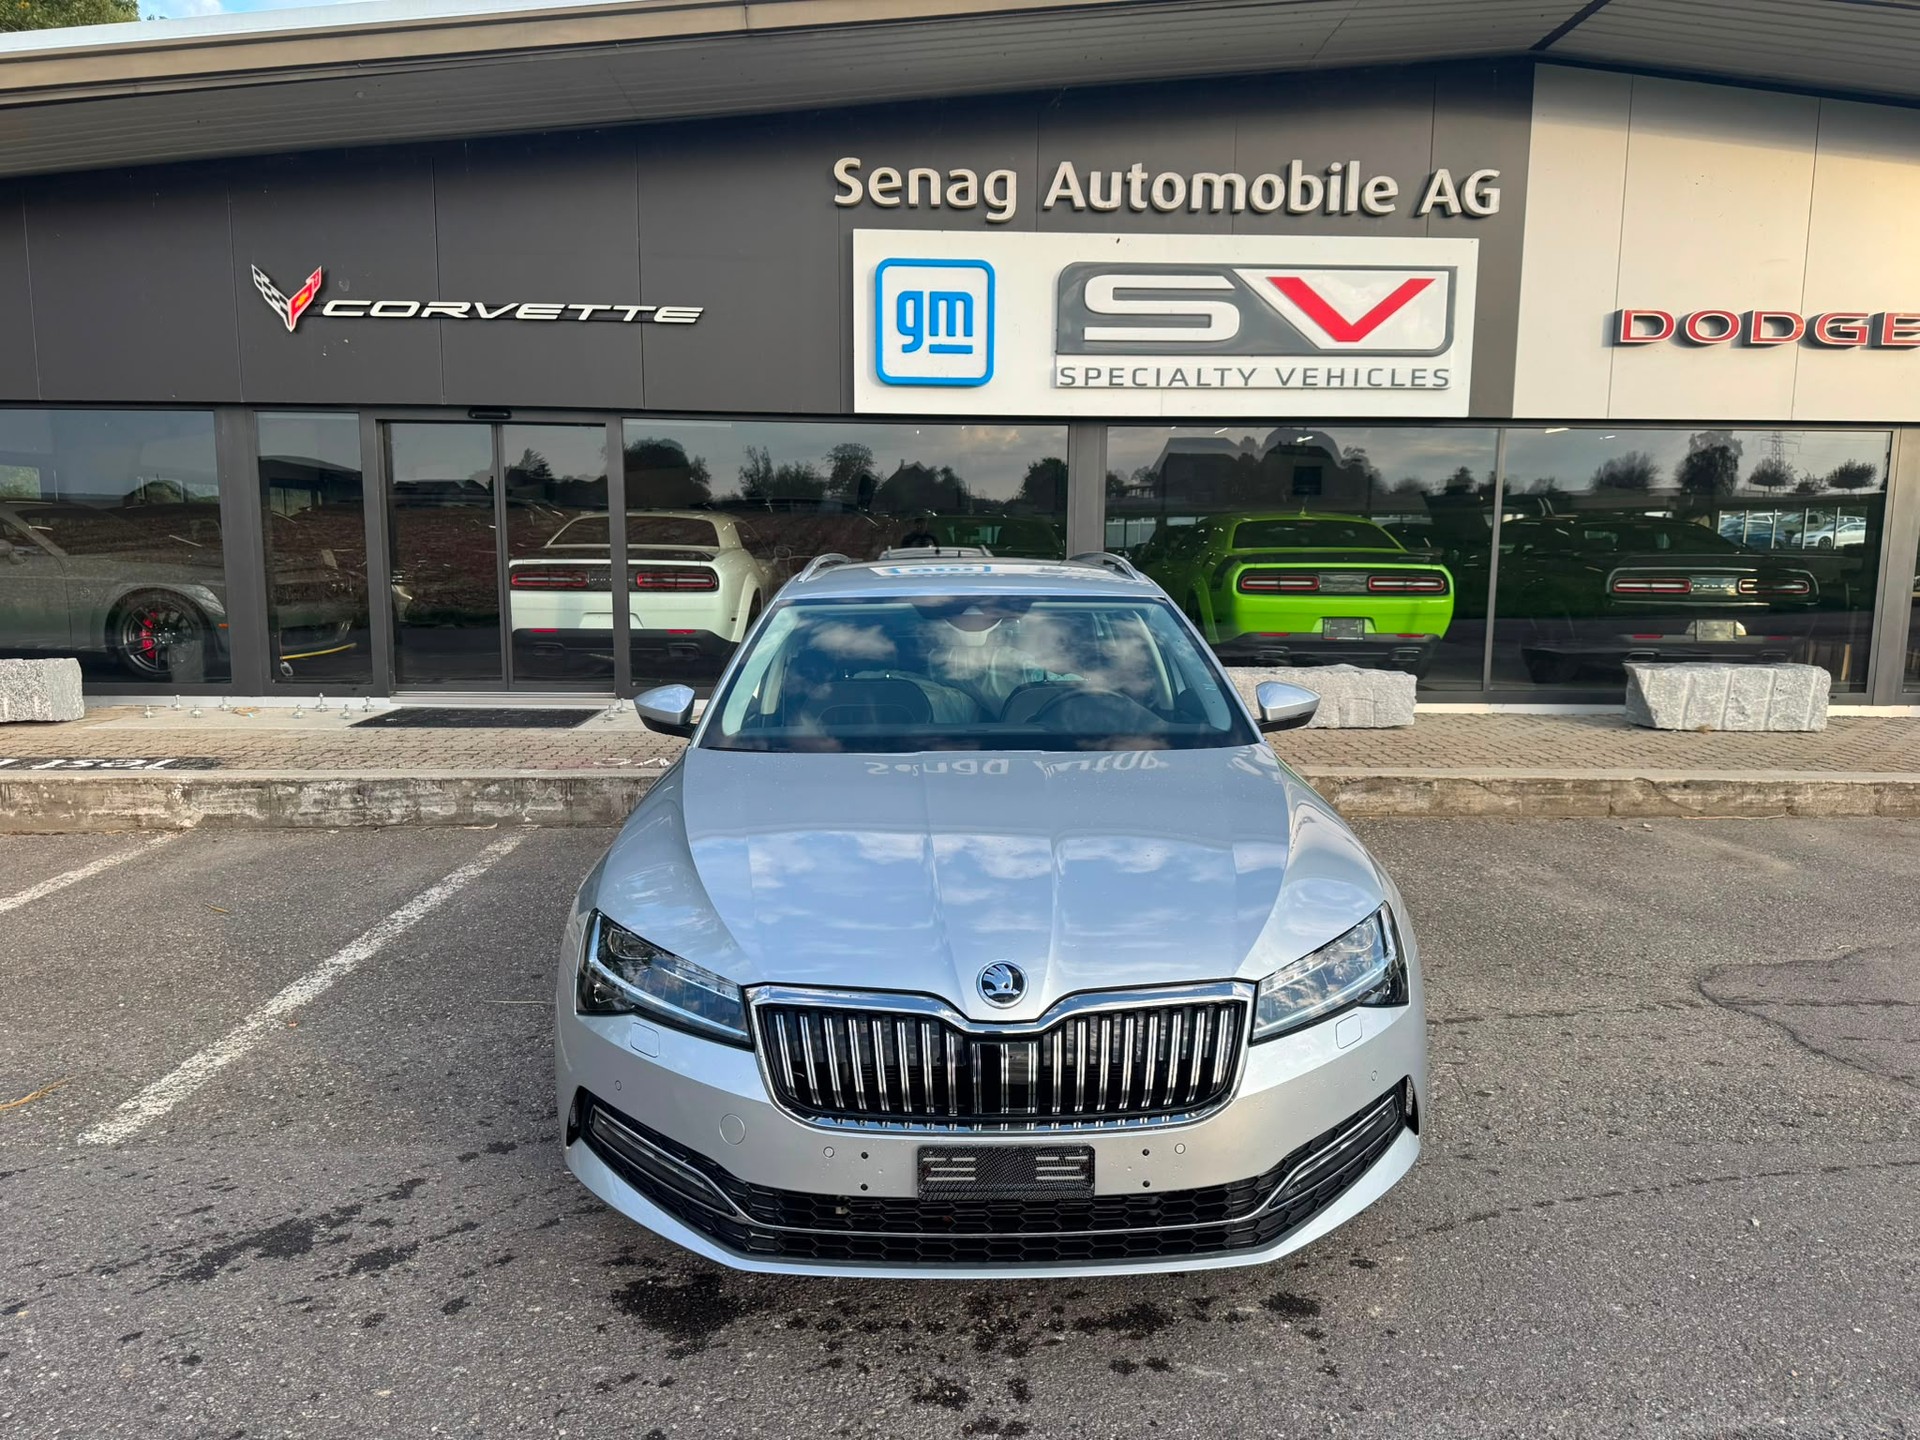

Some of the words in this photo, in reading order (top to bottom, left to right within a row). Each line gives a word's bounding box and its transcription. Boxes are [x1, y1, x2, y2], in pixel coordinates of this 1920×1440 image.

[833, 157, 1017, 224] Senag
[1043, 159, 1399, 216] Automobile
[1419, 168, 1501, 217] AG
[322, 299, 704, 324] CORVETTE
[896, 290, 974, 354] gm
[1615, 308, 1920, 347] DODGE
[1059, 366, 1257, 388] SPECIALTY
[1275, 367, 1451, 388] VEHICLES
